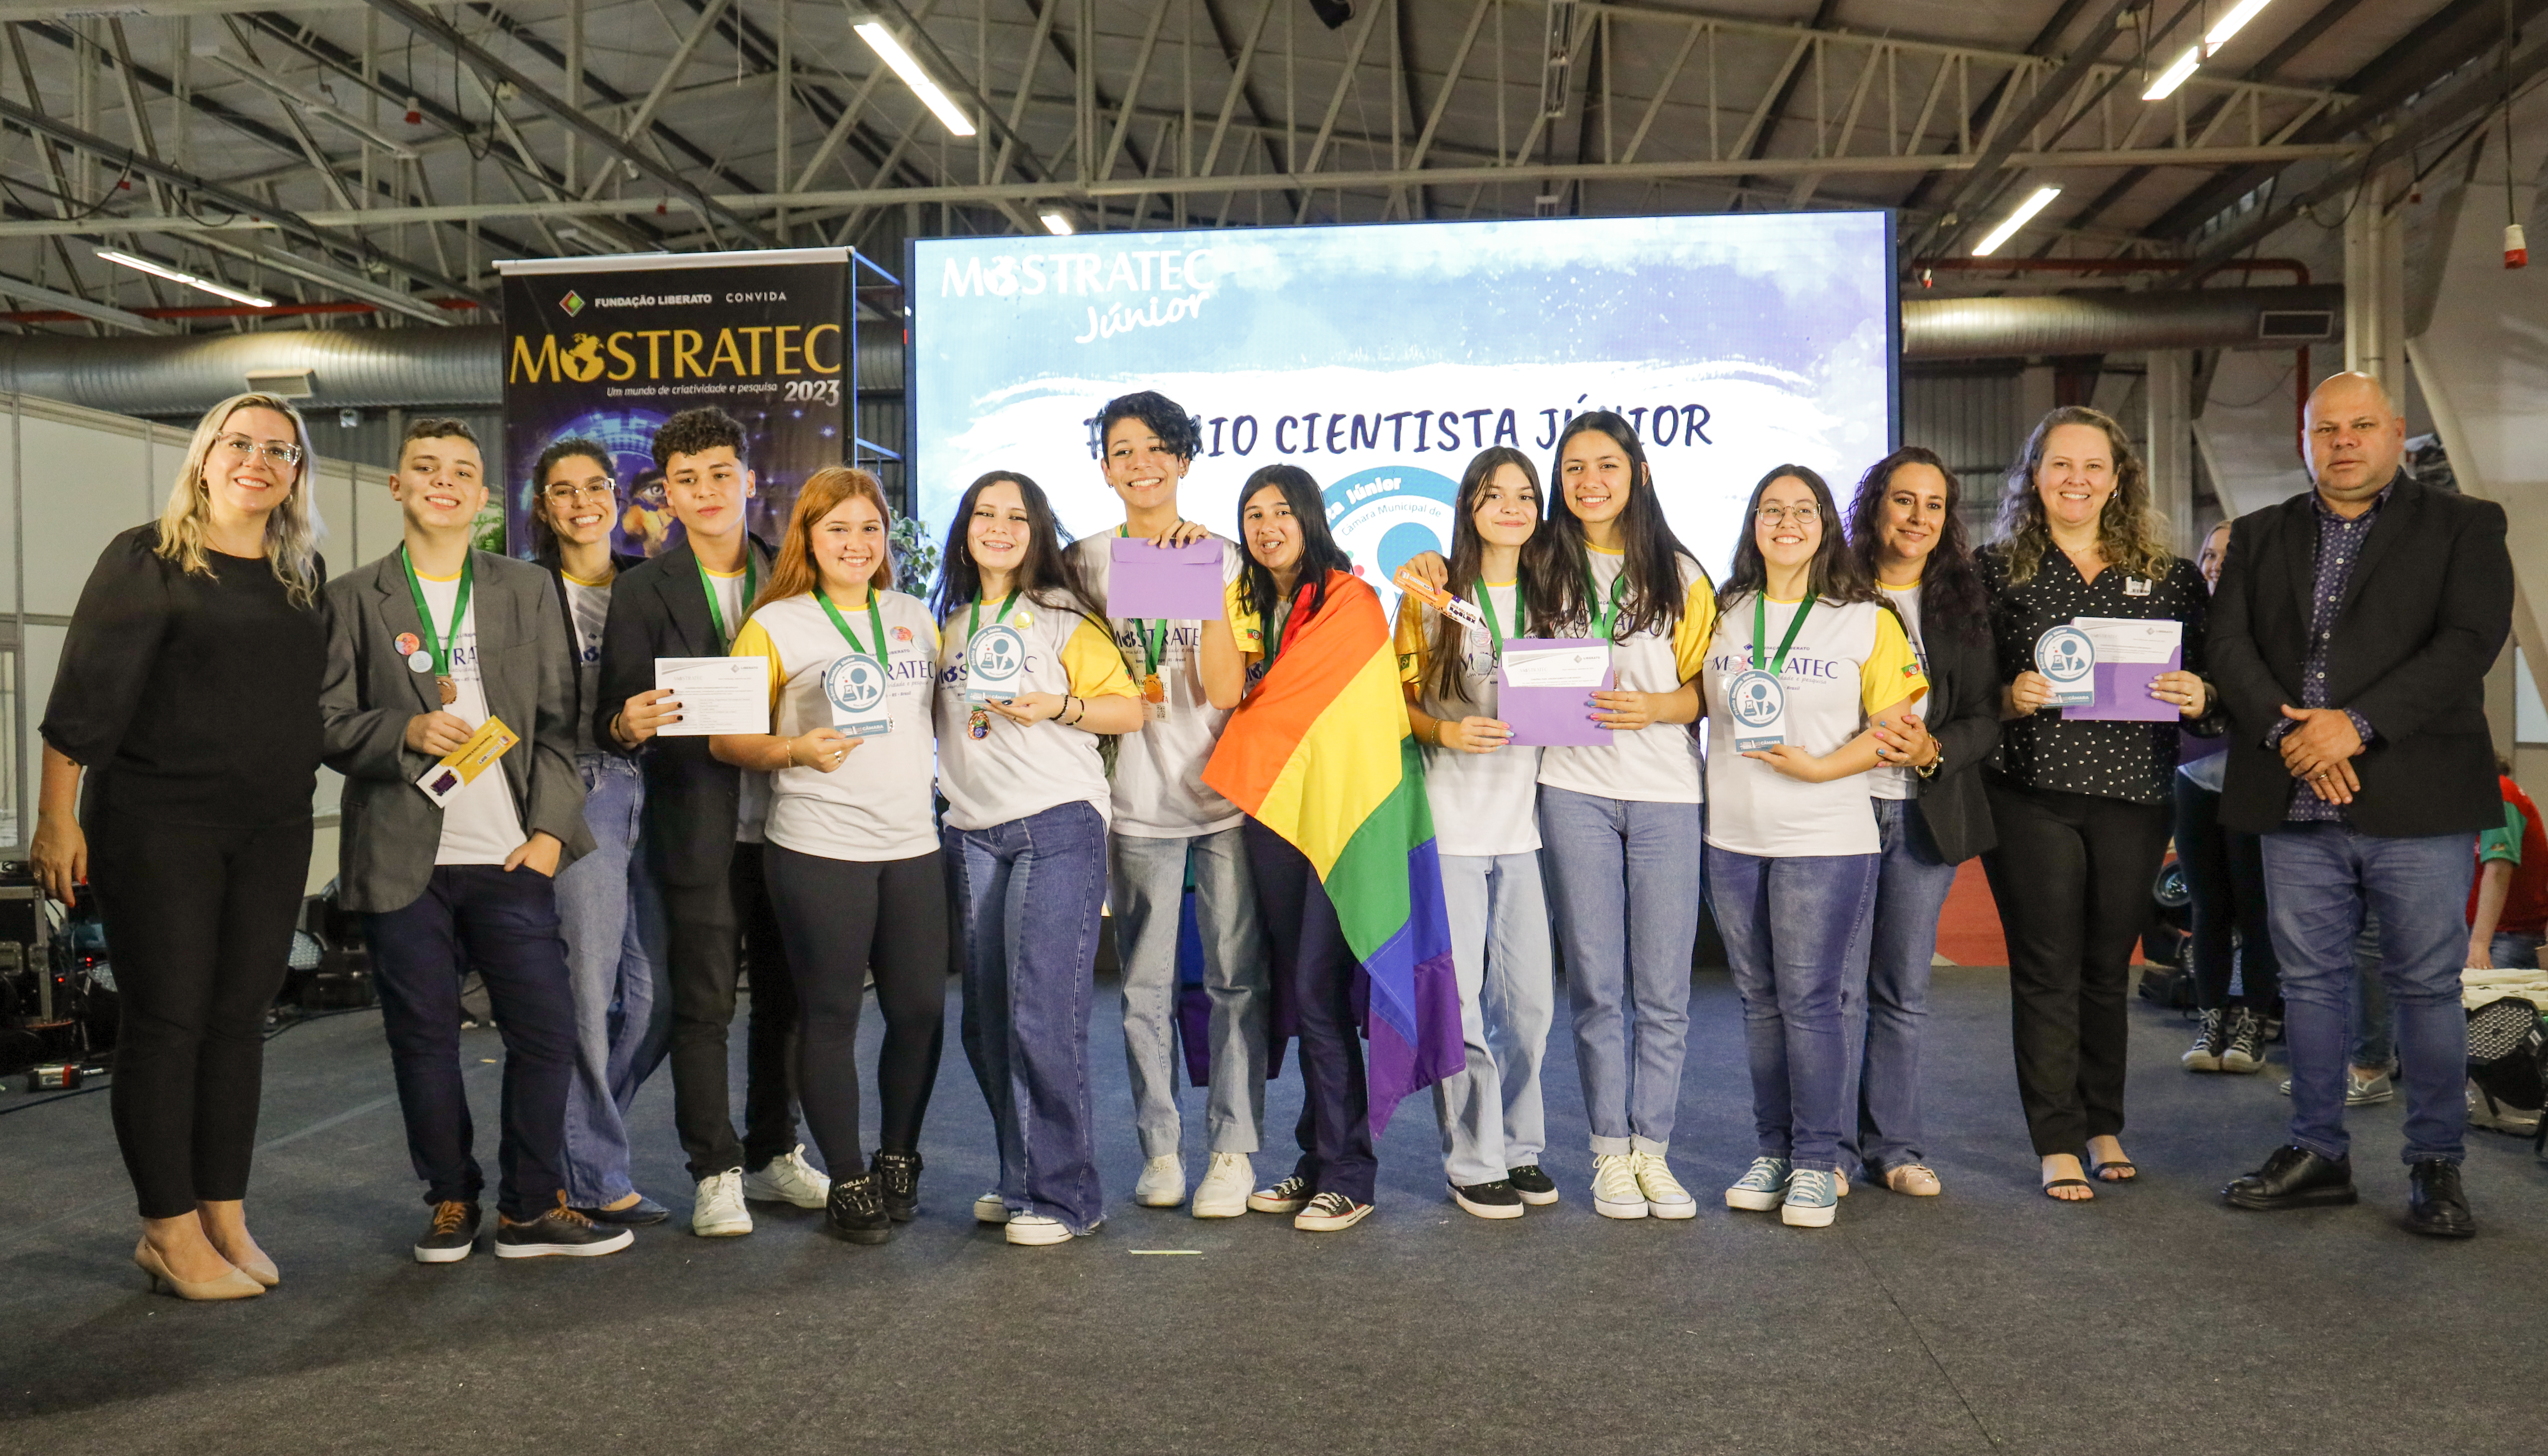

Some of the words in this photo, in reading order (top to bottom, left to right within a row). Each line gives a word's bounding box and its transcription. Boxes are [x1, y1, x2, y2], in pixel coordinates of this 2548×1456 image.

[941, 249, 1214, 297] MOSTRATEC
[595, 294, 656, 308] FUNDAÇÃO
[657, 293, 712, 305] LIBERATO
[726, 291, 787, 303] CONVIDA
[1074, 291, 1210, 343] Júnior
[509, 323, 842, 384] MOSTRATEC
[606, 386, 623, 396] Um
[624, 385, 656, 396] mundo
[657, 385, 669, 395] de
[672, 383, 727, 394] criatividade
[737, 382, 778, 394] pesquisa
[783, 379, 840, 407] 2023
[1275, 407, 1521, 455] CIENTISTA
[1536, 394, 1713, 450] JIOR
[1346, 476, 1402, 505] Júnior
[1377, 502, 1427, 515] Municipal
[1429, 507, 1441, 517] de
[1801, 677, 1827, 685] pesquisa
